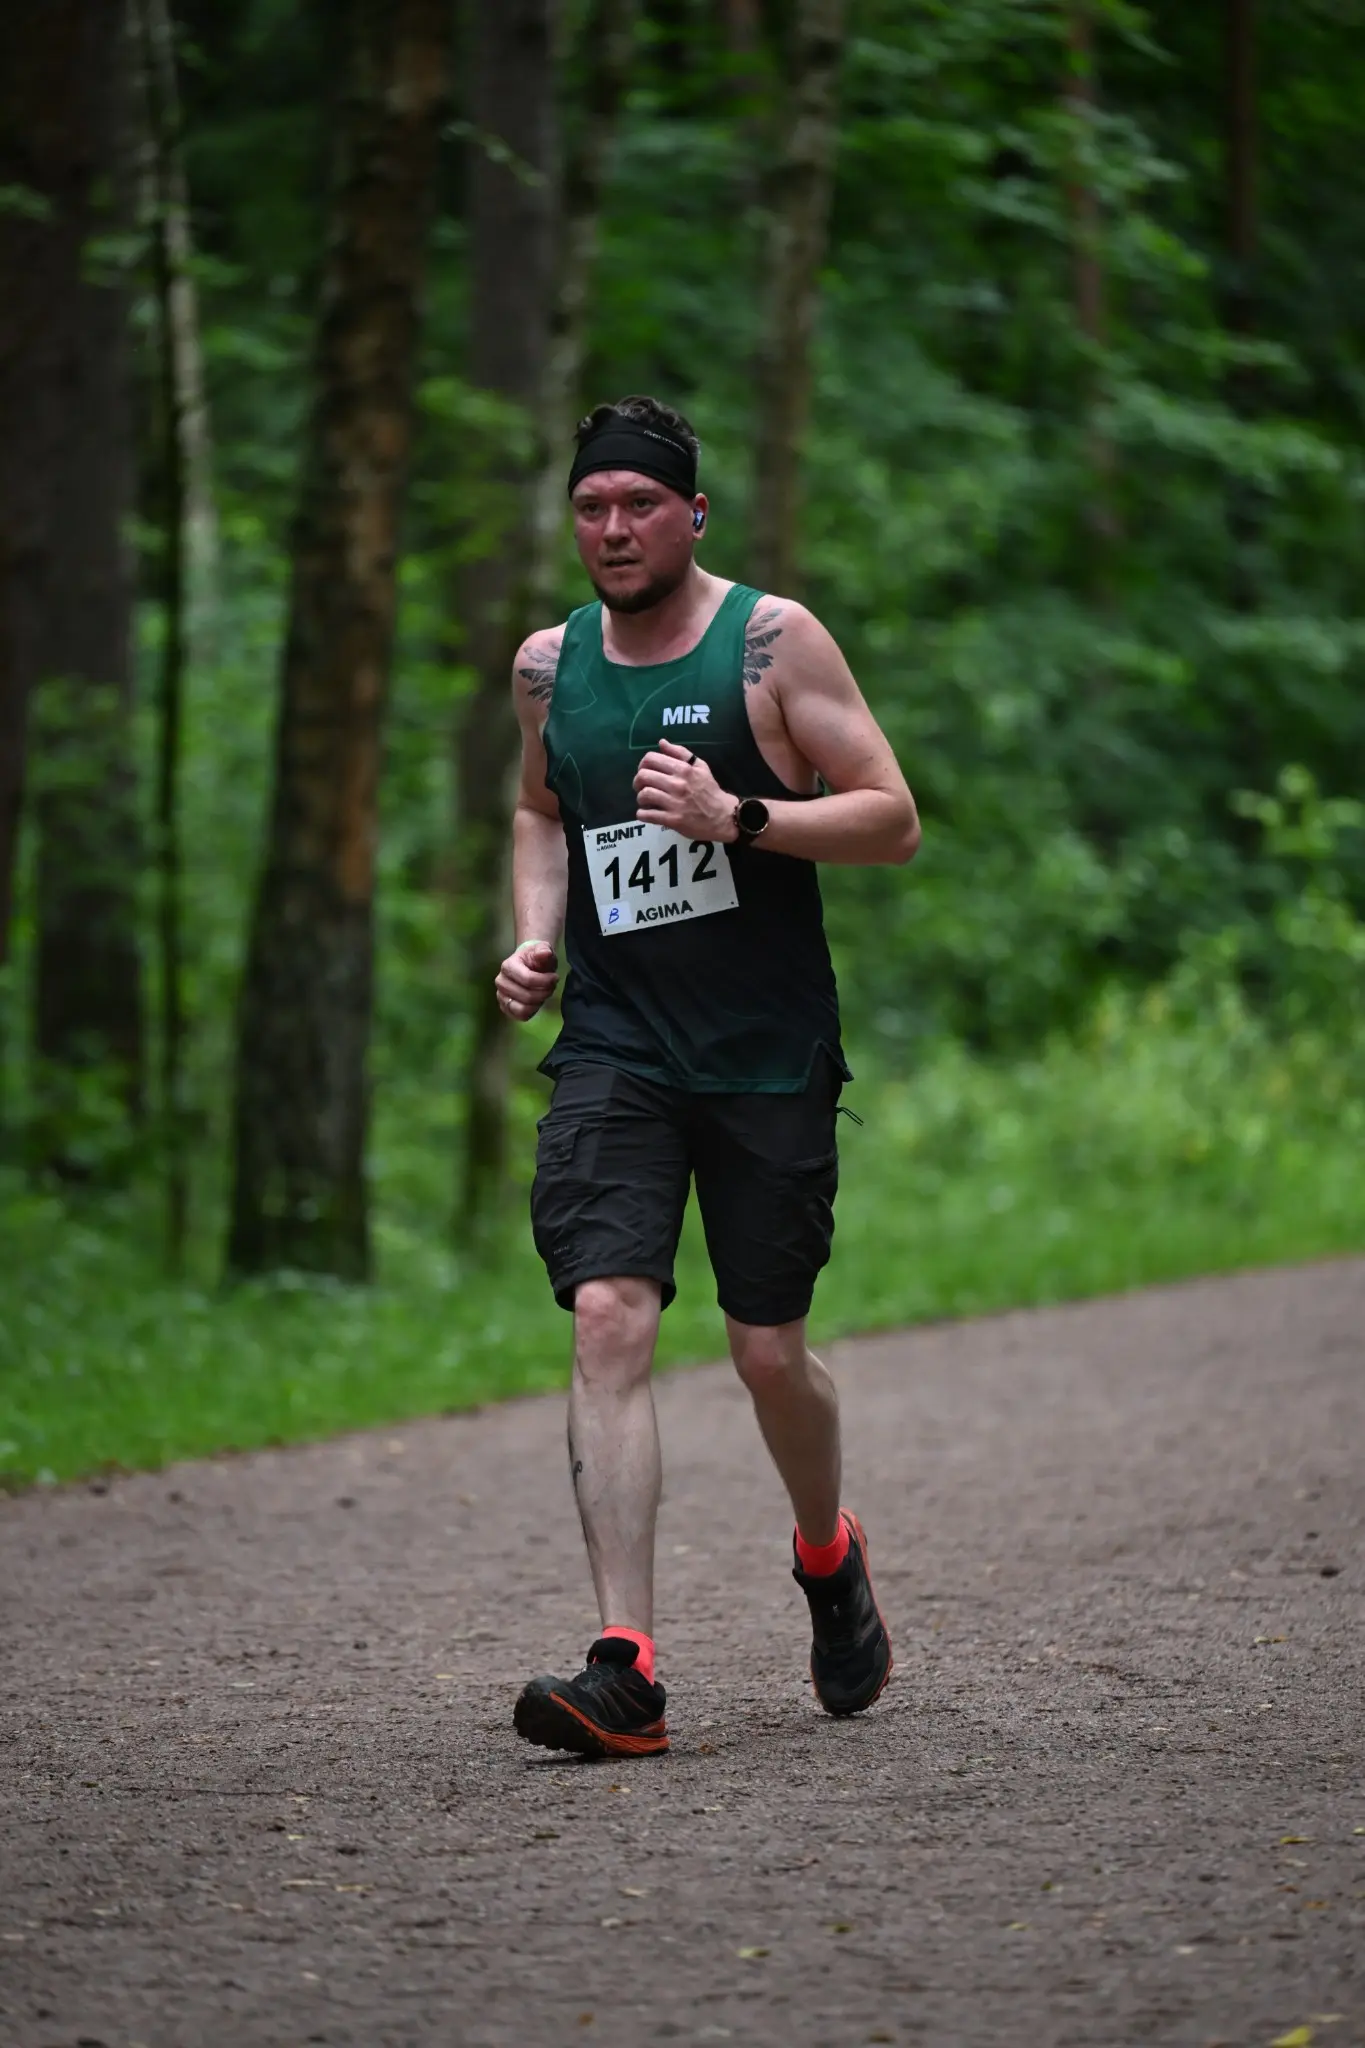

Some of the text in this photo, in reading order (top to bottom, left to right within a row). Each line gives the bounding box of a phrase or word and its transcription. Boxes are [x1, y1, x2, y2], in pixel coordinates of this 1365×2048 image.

[662, 704, 711, 727] MIR
[596, 824, 646, 845] RUNIT
[604, 840, 717, 900] 1412
[635, 899, 694, 924] AGIMA
